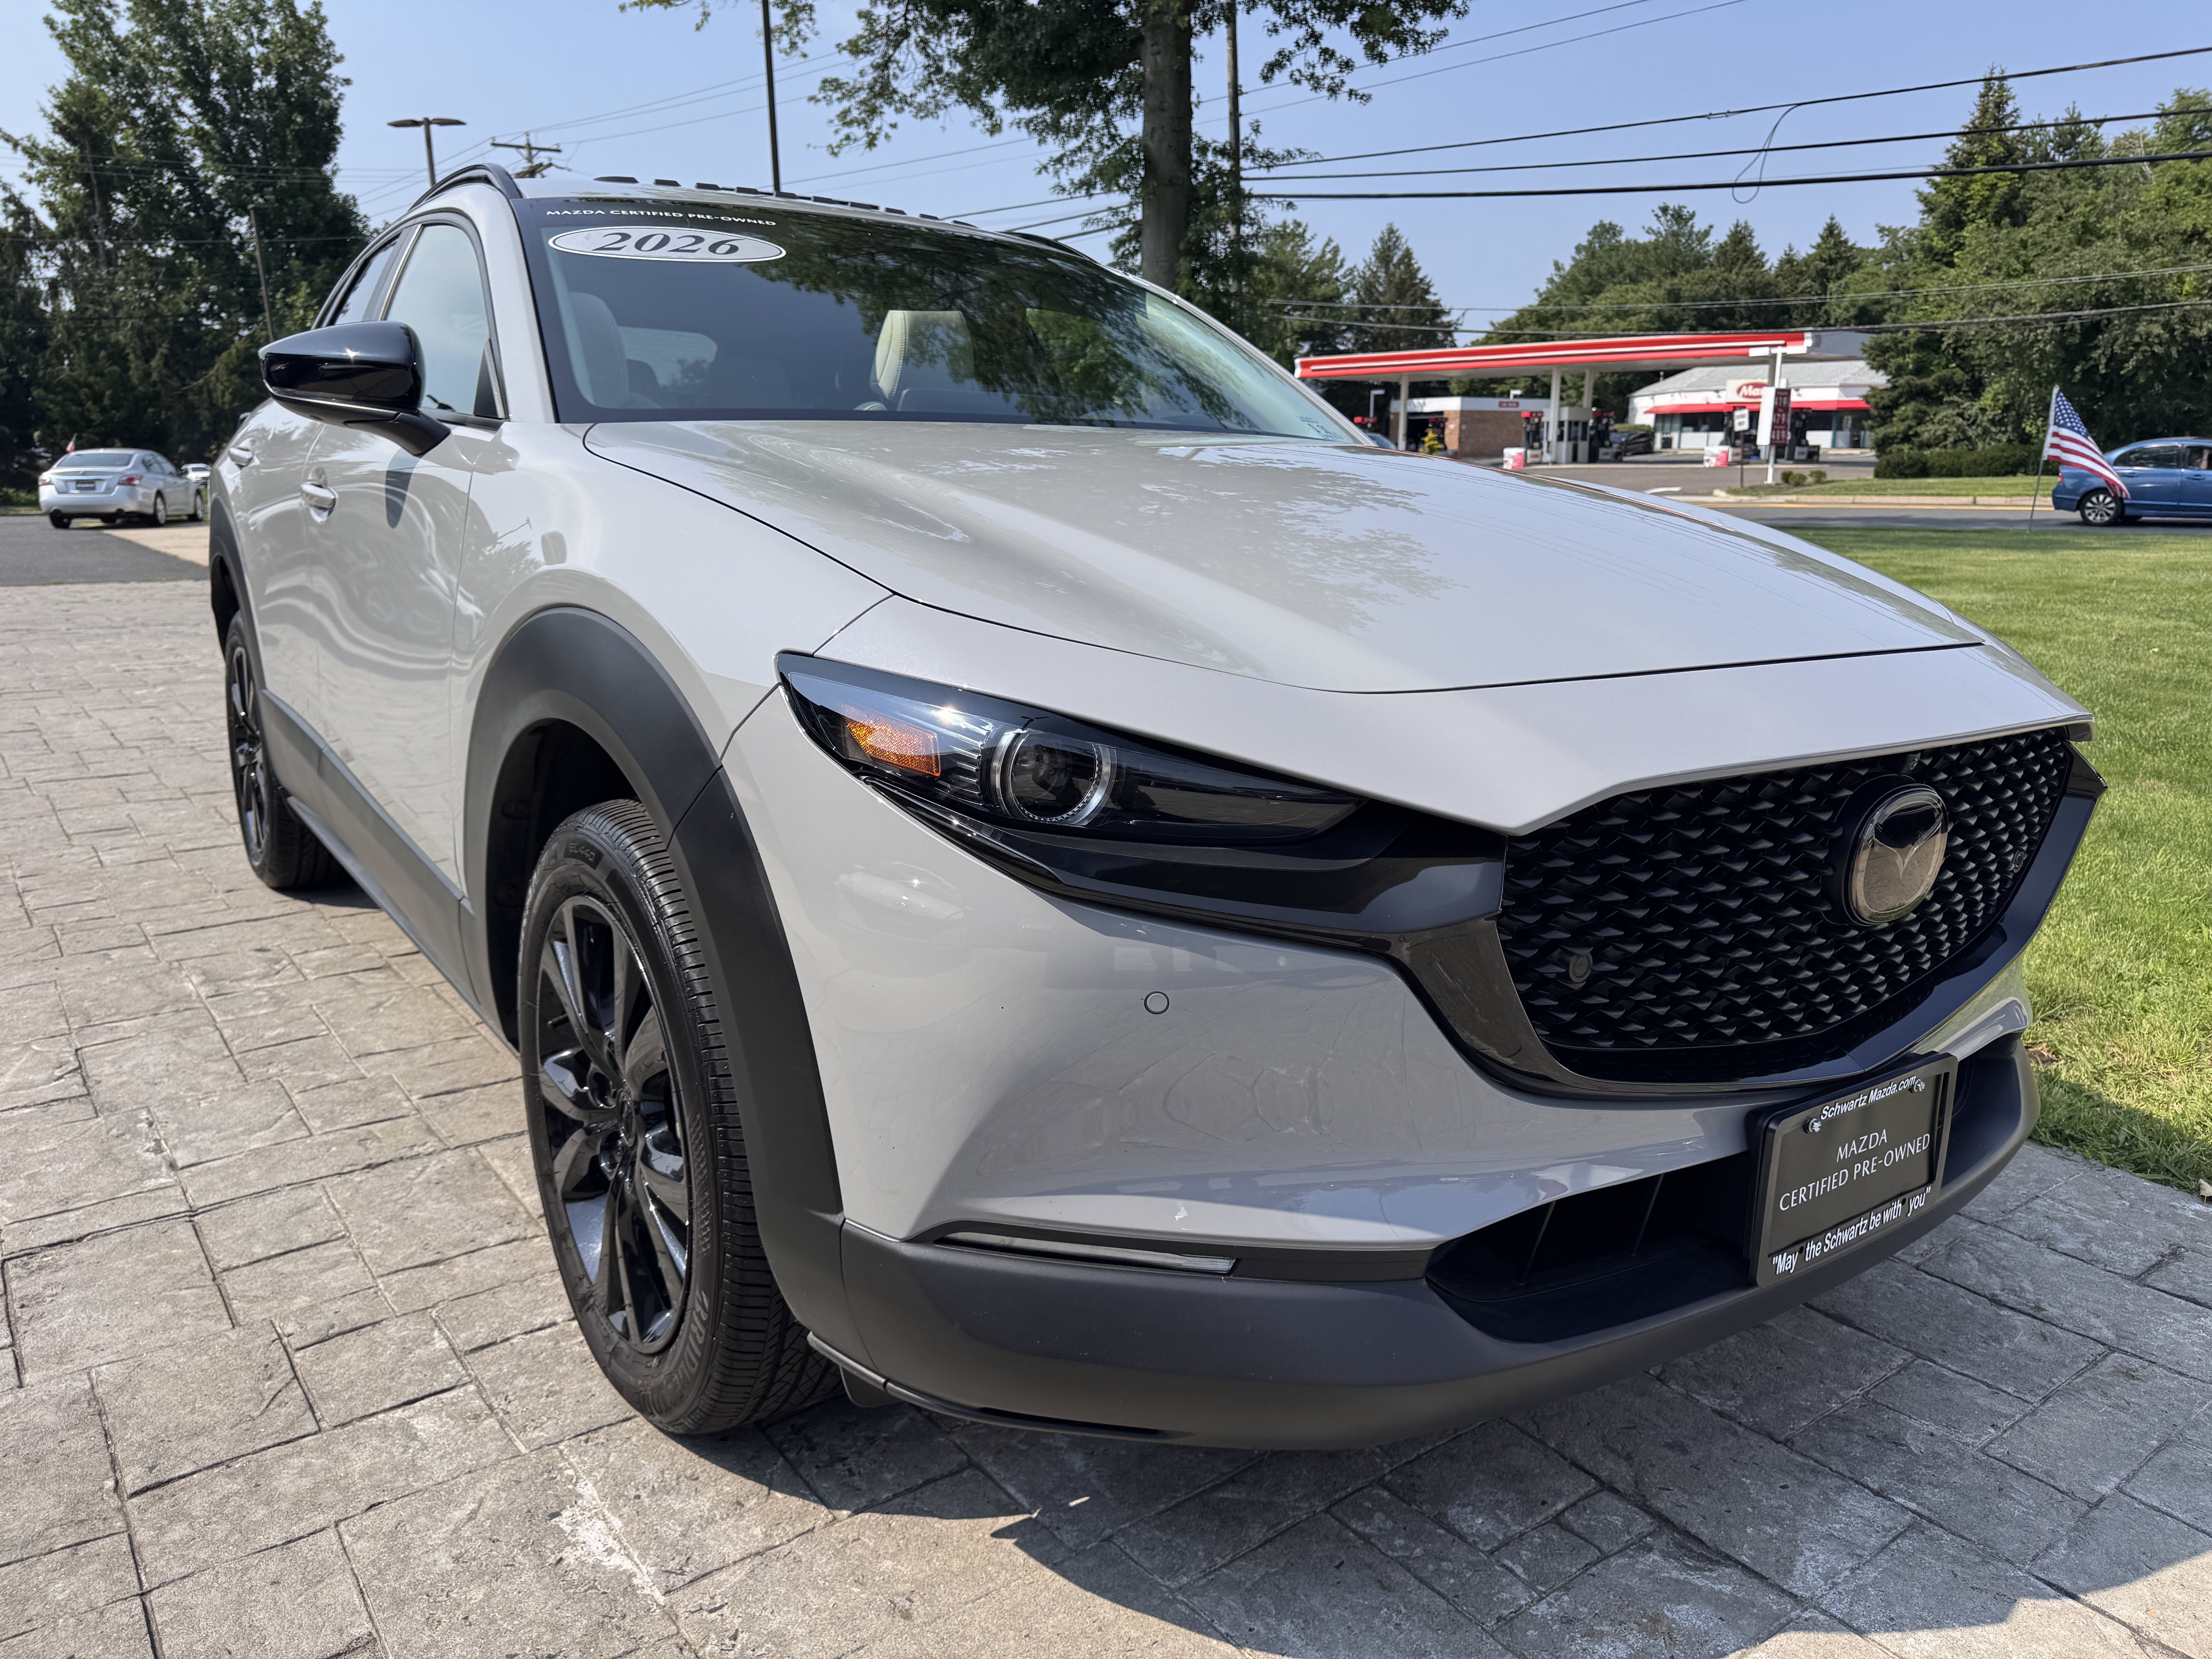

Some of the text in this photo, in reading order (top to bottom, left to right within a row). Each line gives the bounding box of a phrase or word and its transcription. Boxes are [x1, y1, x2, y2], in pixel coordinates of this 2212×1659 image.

[688, 213, 776, 225] PRE-OWNED
[591, 232, 745, 255] 2026
[1738, 385, 1763, 397] Ma
[1820, 1075, 1916, 1120] Schwartz Mazda.com
[1836, 1129, 1887, 1163] MAZDA
[1779, 1133, 1930, 1211] CERTIFIED PRE-OWNED
[1772, 1186, 1931, 1274] "May the Schwartz be with you"
